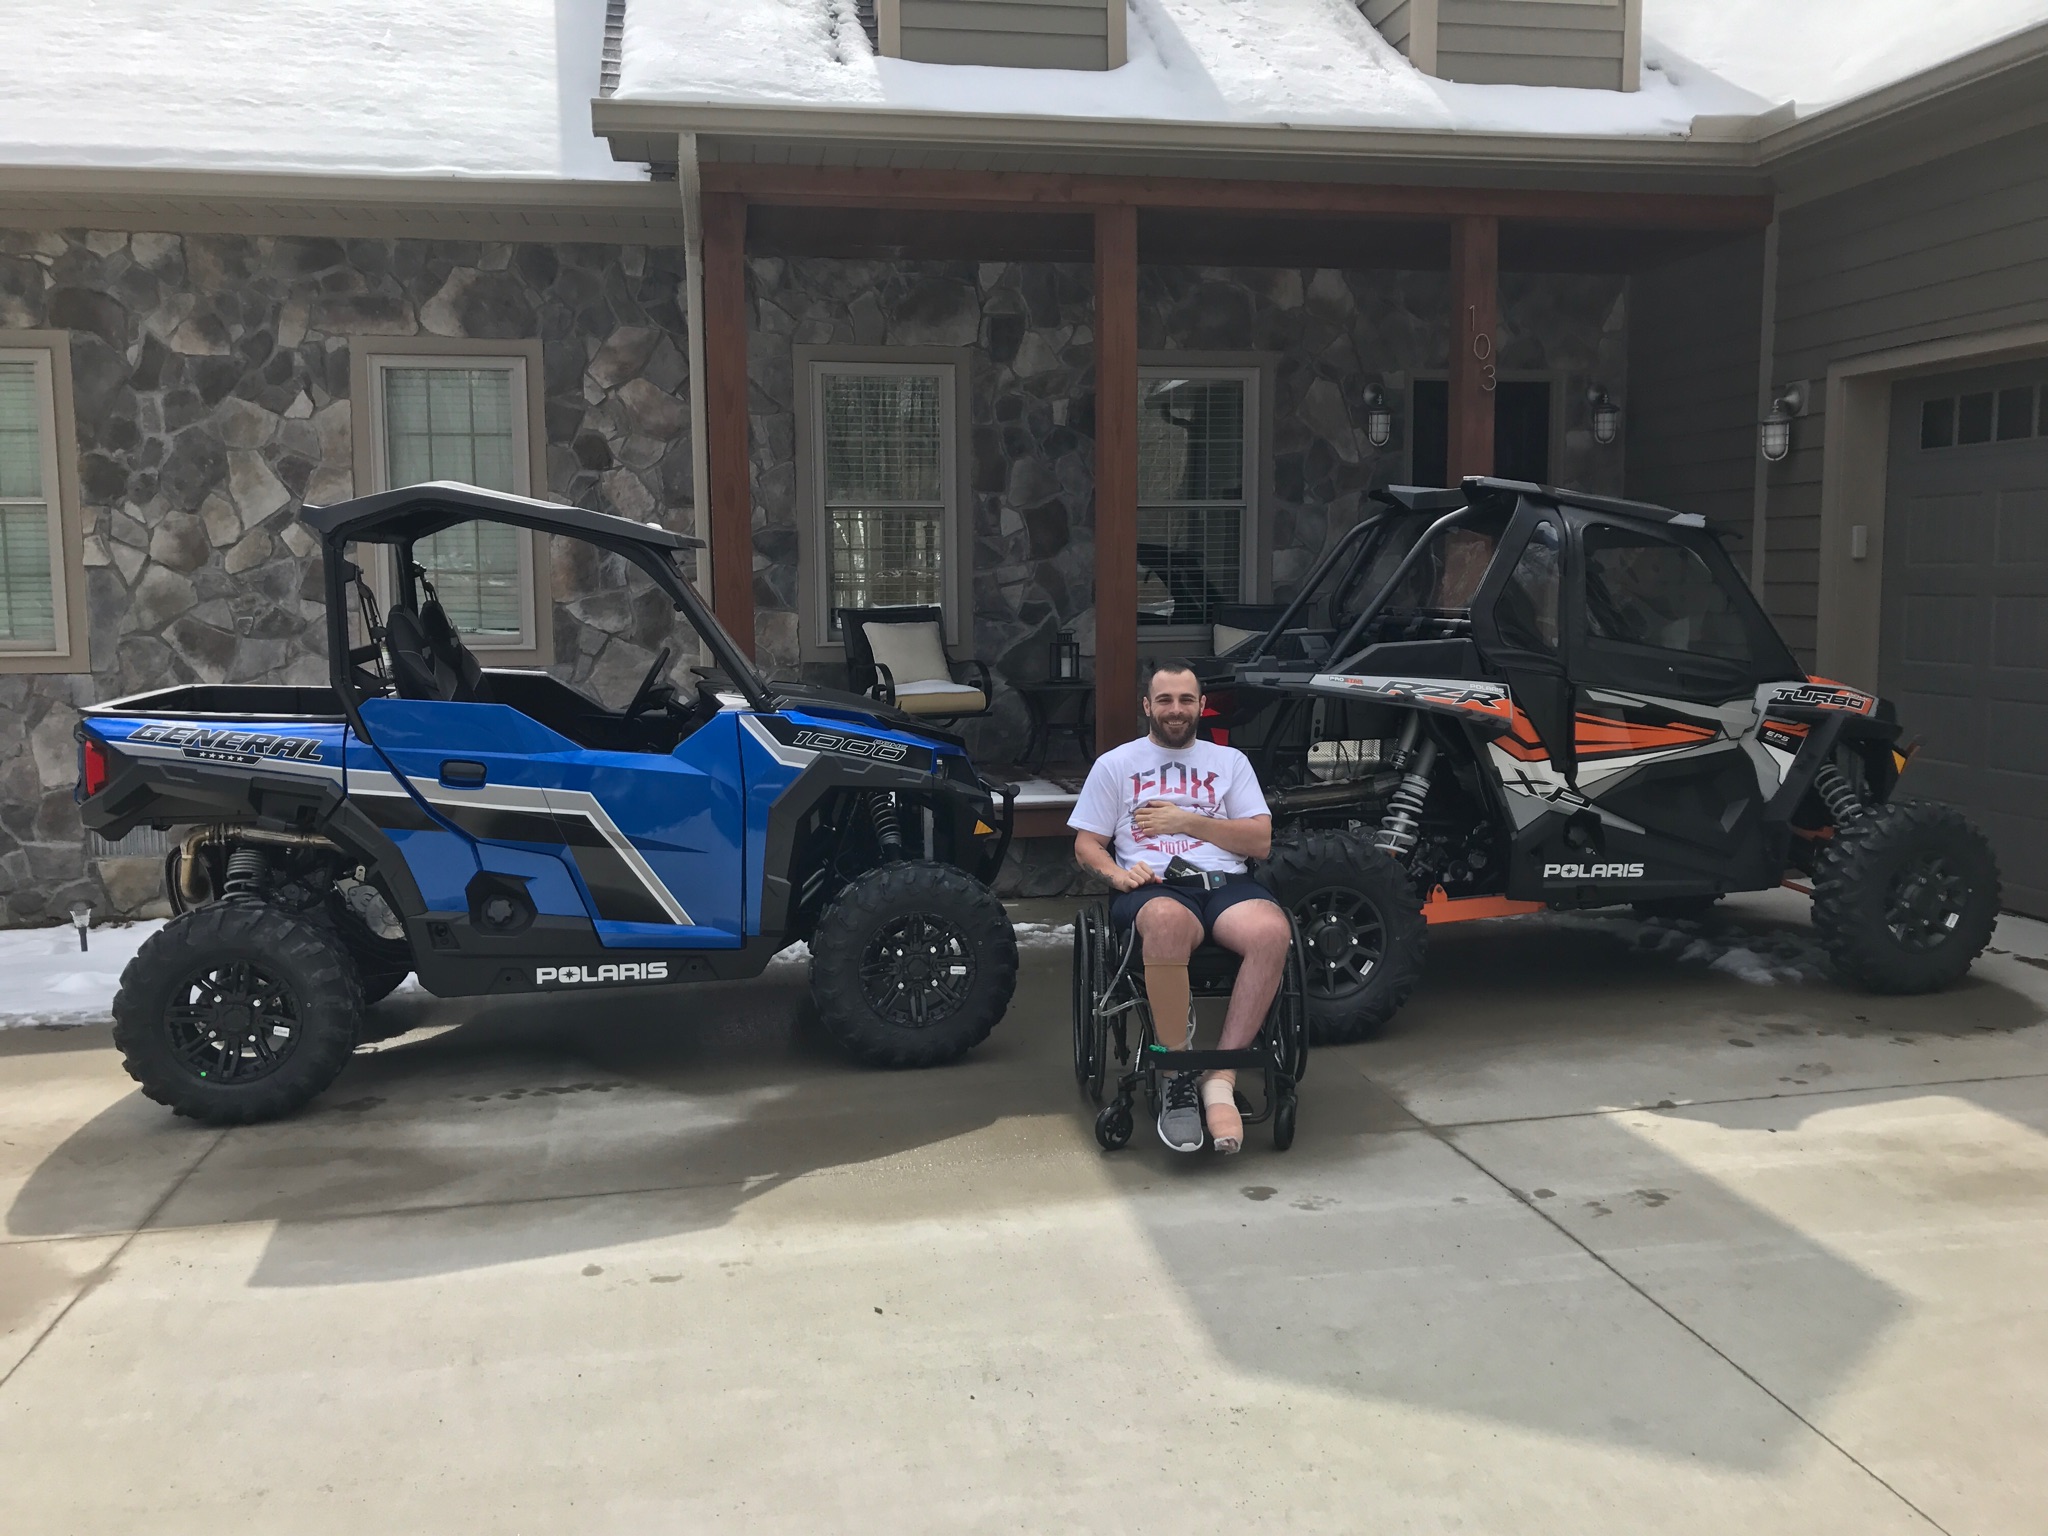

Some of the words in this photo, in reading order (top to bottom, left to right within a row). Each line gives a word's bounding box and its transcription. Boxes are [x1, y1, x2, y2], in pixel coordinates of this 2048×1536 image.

[1469, 304, 1497, 391] 103
[1377, 680, 1505, 709] RZR
[1469, 683, 1505, 694] POLARIS
[1772, 688, 1866, 711] TURBO
[127, 724, 323, 762] GENERAL
[793, 730, 907, 762] 1000
[1766, 730, 1791, 742] EPS
[1129, 761, 1220, 804] FOX
[1160, 840, 1190, 856] MOTO
[1543, 863, 1645, 878] POLARIS
[536, 961, 669, 985] POLARIS
